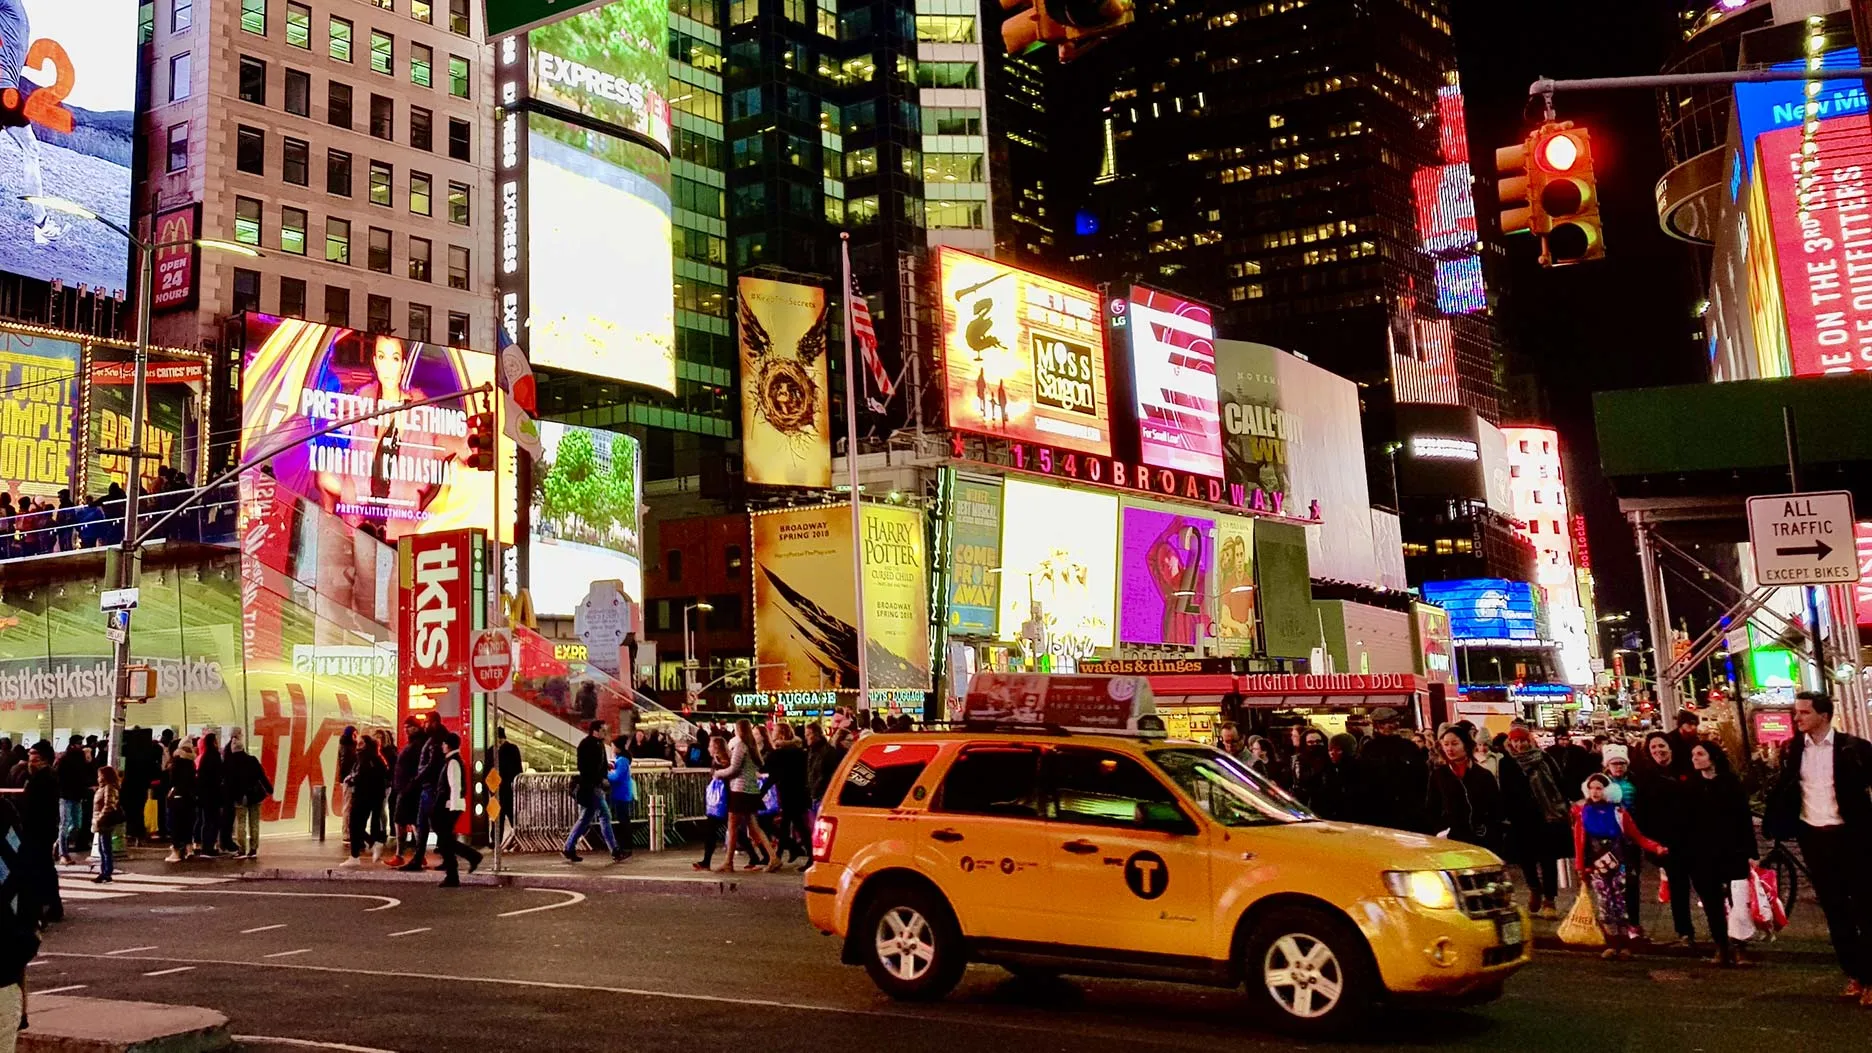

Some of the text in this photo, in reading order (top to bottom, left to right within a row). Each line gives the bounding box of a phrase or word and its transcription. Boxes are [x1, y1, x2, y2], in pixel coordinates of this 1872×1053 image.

[538, 51, 644, 110] EXPRESS
[503, 182, 517, 274] EXPRESS
[160, 257, 187, 273] OPEN
[162, 271, 183, 290] 24
[1806, 259, 1843, 305] THE
[155, 287, 189, 304] HOURS
[1112, 316, 1126, 327] LG
[1816, 312, 1850, 346] ON
[15, 363, 72, 406] JUST
[1037, 364, 1094, 410] Saigon
[0, 398, 73, 442] IMPLE
[1224, 402, 1275, 438] CALL
[101, 408, 174, 474] BRNX
[0, 435, 71, 485] ONGE
[310, 444, 374, 477] KOURTNEY
[1012, 444, 1285, 513] 1540 BROADWAY
[1784, 500, 1817, 517] ALL
[779, 530, 830, 541] SPRING 2018
[780, 521, 828, 533] BROADWAY
[866, 516, 914, 544] HARRY
[1772, 520, 1833, 537] TRAFFIC
[1575, 514, 1590, 567] oot Locker
[864, 539, 919, 568] POTTER
[955, 543, 996, 567] COME
[954, 563, 996, 588] FROM
[1766, 566, 1850, 581] EXCEPT BIKES
[416, 543, 459, 669] tkts
[877, 601, 911, 610] BROADWAY
[953, 584, 995, 606] AWAY
[876, 610, 899, 619] SPRING
[490, 640, 505, 653] NOT
[480, 668, 504, 680] ENTER
[1080, 659, 1202, 673] wafels & dinges
[1246, 672, 1404, 691] MIGHTY QUINN'S BBQ
[734, 692, 836, 706] GIFTS LUGGAGE
[1134, 860, 1159, 893] T
